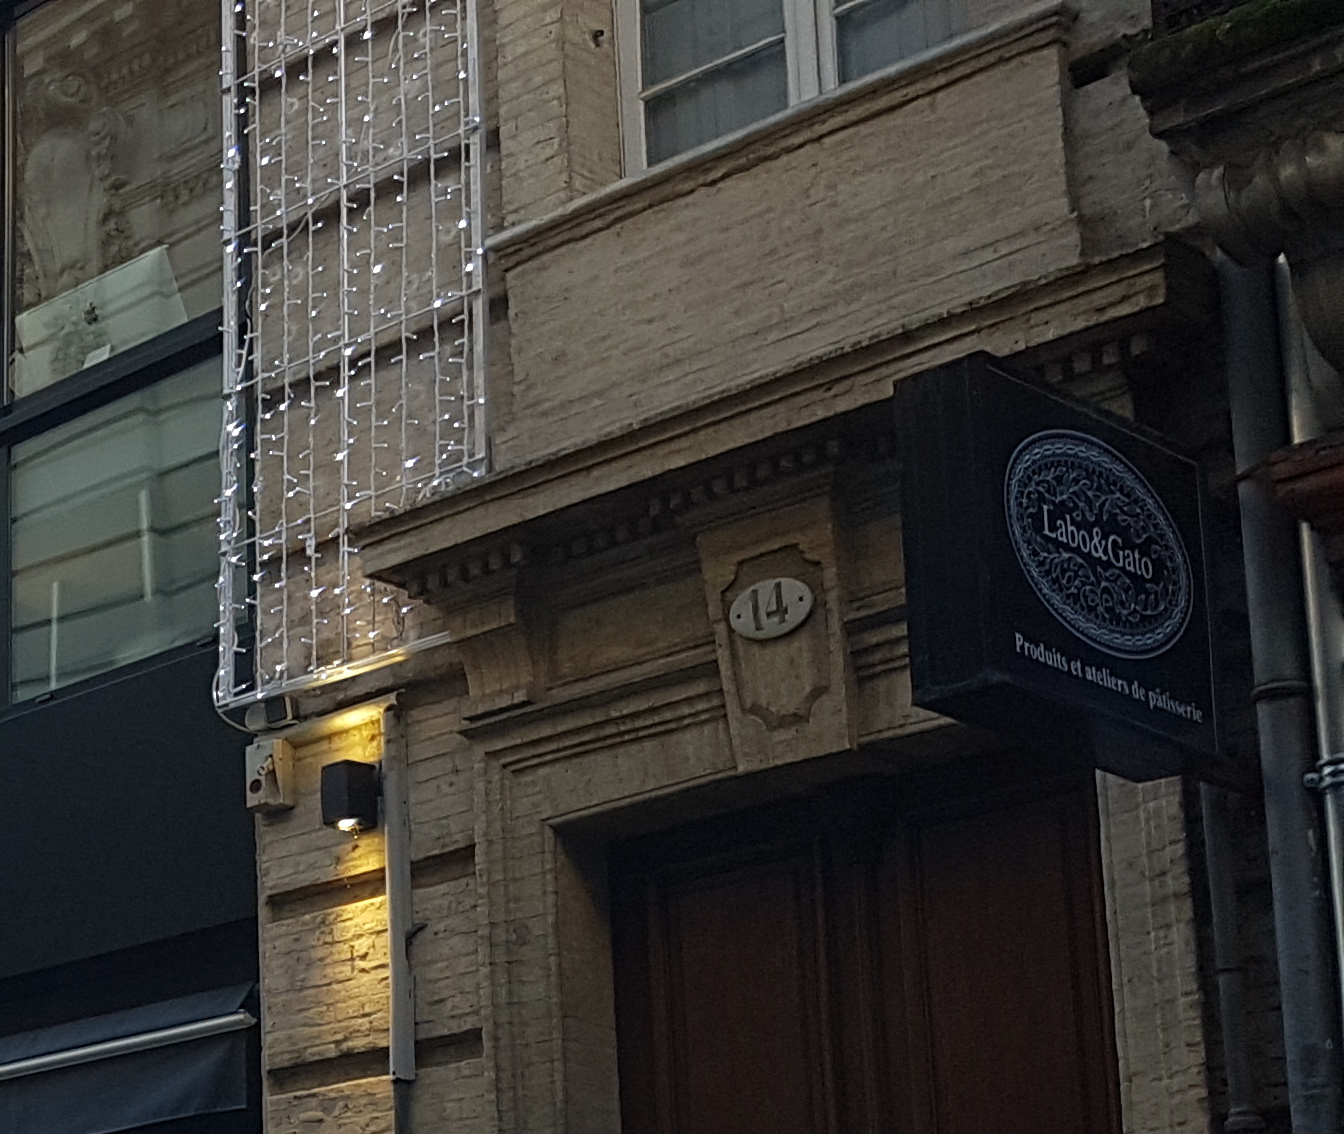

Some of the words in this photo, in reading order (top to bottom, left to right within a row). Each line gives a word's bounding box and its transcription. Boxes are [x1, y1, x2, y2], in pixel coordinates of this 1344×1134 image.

[1042, 504, 1153, 580] Labo&Gato
[750, 581, 789, 632] 14
[1014, 632, 1068, 672] Produits
[1070, 659, 1083, 677] et
[1084, 665, 1130, 695] ateliers
[1131, 680, 1146, 701] de
